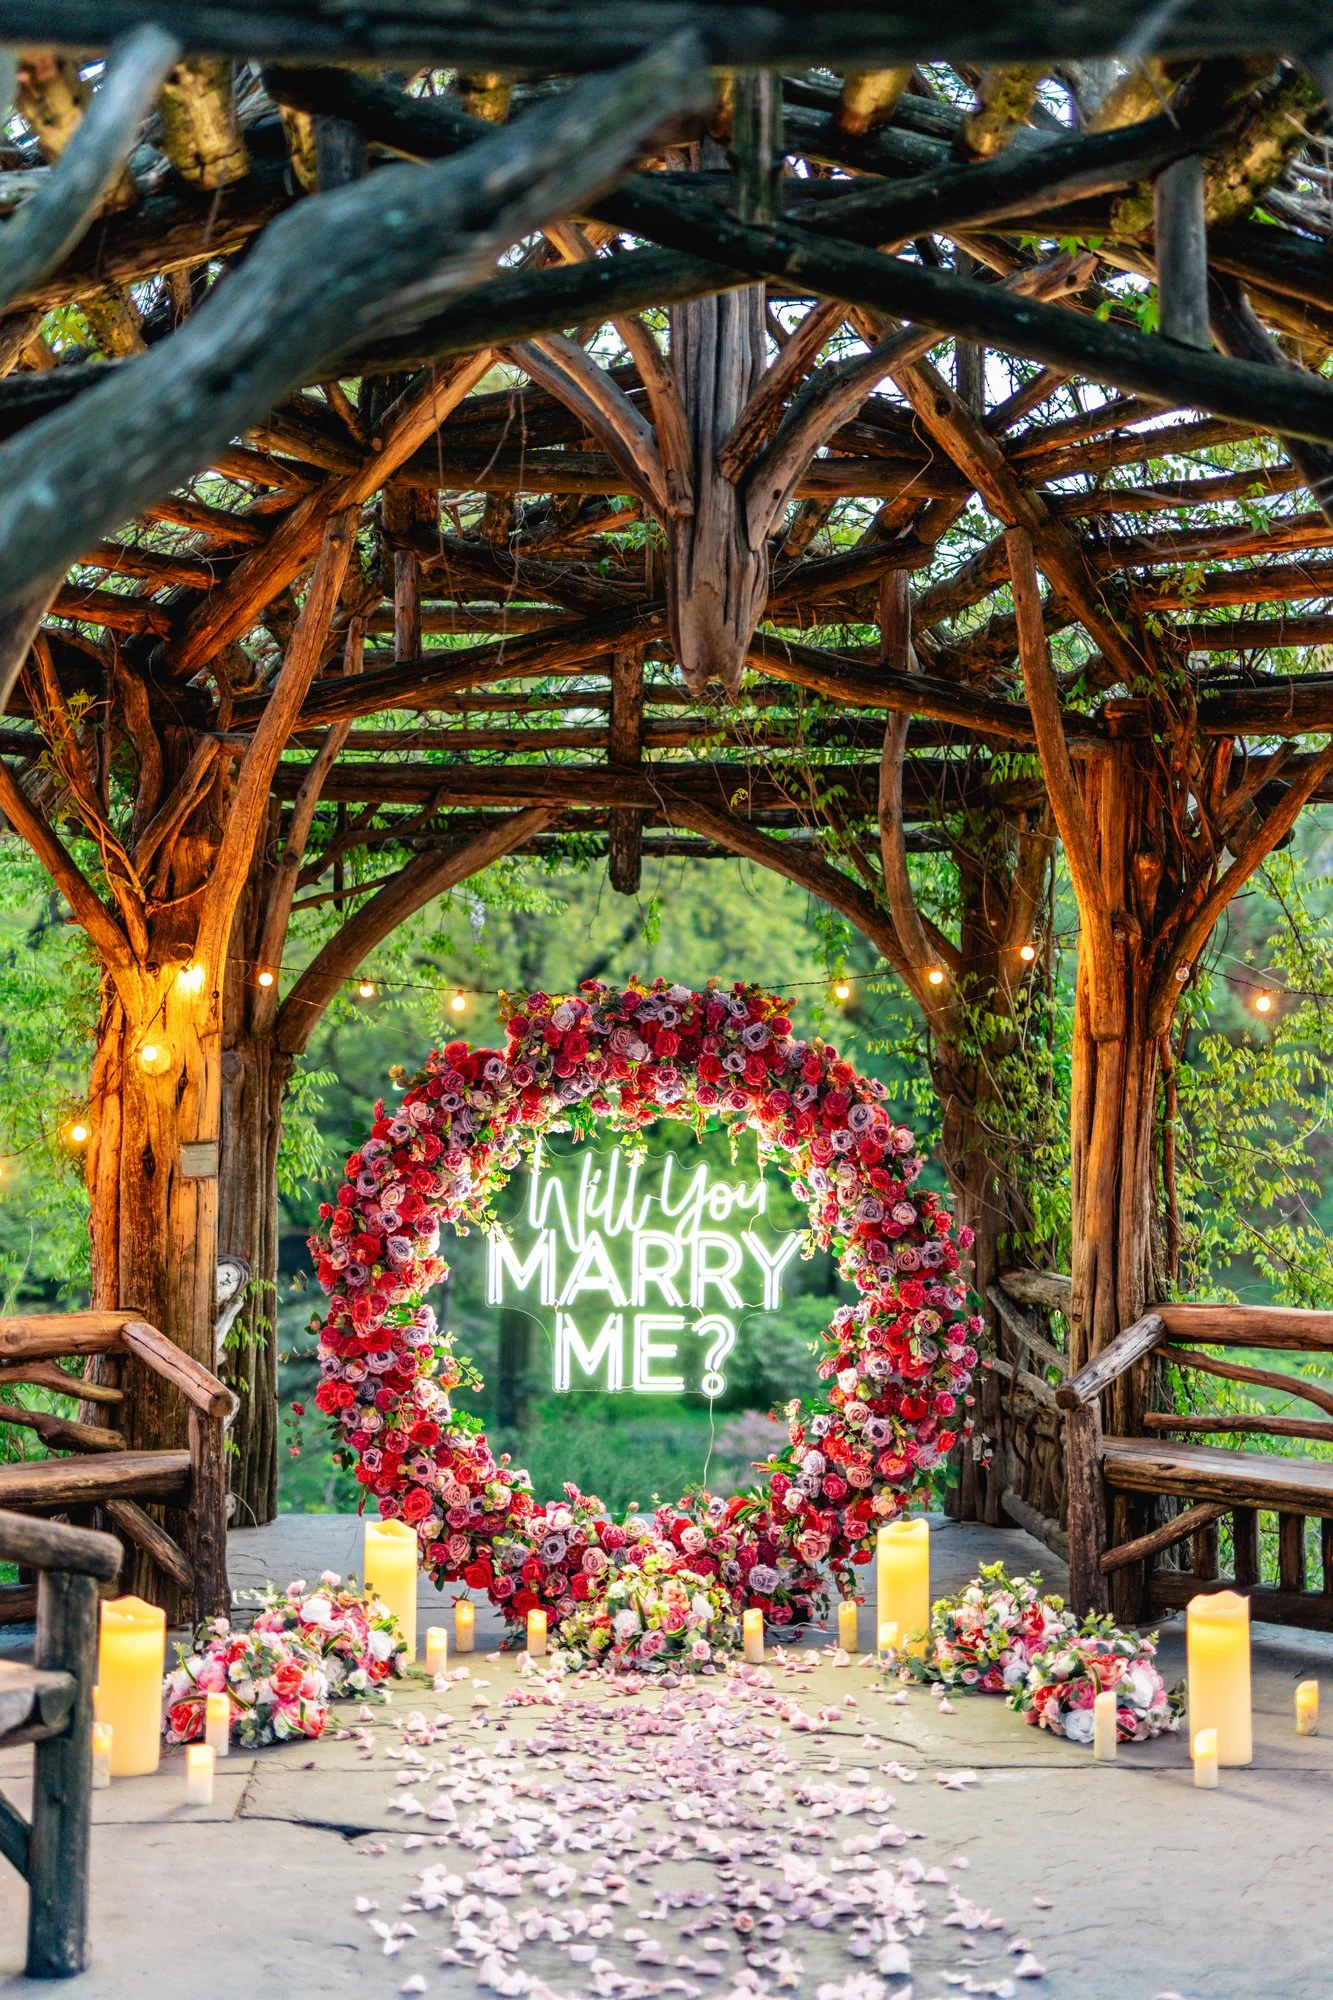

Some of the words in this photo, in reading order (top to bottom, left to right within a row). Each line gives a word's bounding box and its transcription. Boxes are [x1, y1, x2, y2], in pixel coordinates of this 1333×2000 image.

[528, 1139, 651, 1254] Will
[660, 1154, 768, 1245] You
[487, 1228, 806, 1310] MARRY
[554, 1311, 737, 1398] ME?
